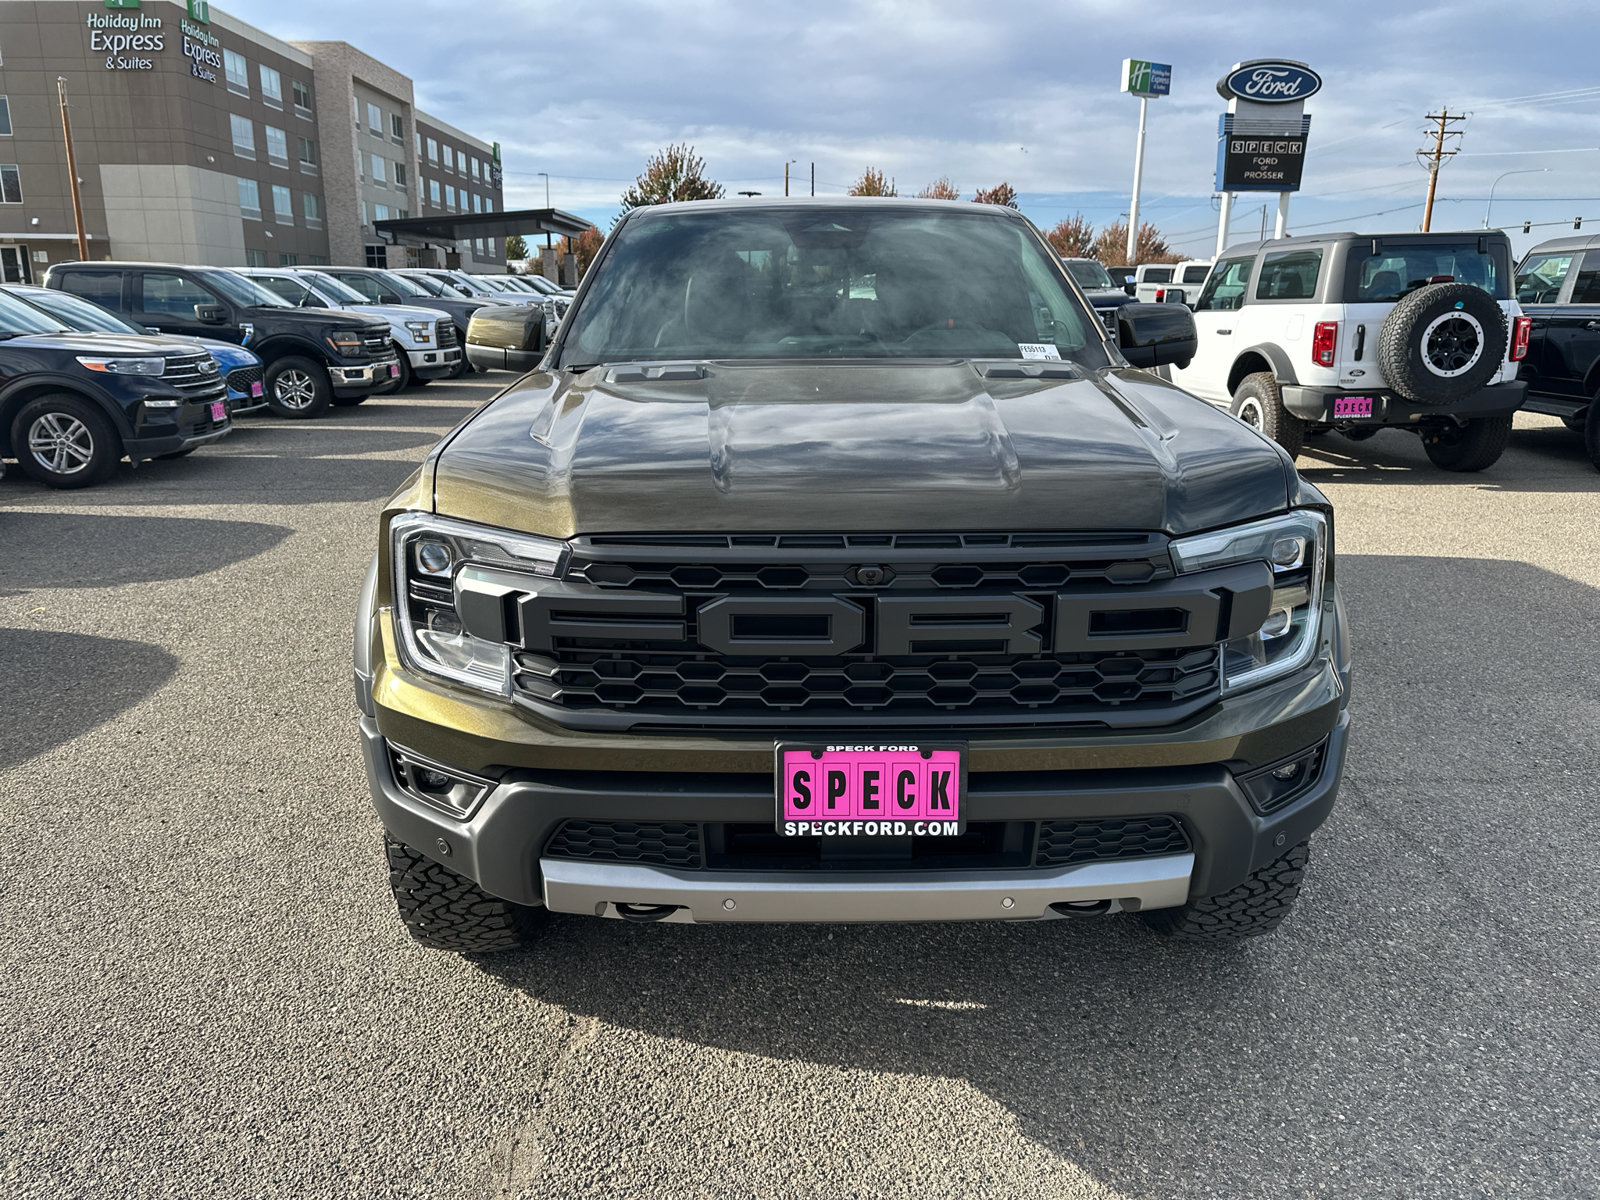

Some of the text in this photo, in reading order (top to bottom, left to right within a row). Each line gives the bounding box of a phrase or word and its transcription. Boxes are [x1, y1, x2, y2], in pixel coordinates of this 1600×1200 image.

[87, 13, 161, 31] Holiday Inn
[179, 18, 219, 47] Holiday Inn
[91, 30, 164, 55] Express
[182, 36, 221, 68] Express
[105, 57, 152, 69] & Suites
[190, 64, 216, 83] & Suites
[1245, 69, 1302, 95] Ford
[1233, 142, 1300, 154] SPECK
[1252, 157, 1278, 165] FORD
[1244, 171, 1284, 179] PROSSER
[1336, 403, 1370, 412] SPECK
[517, 592, 1220, 657] FORD
[793, 770, 951, 810] SPECK
[784, 821, 958, 836] SPECKFORD.COM
